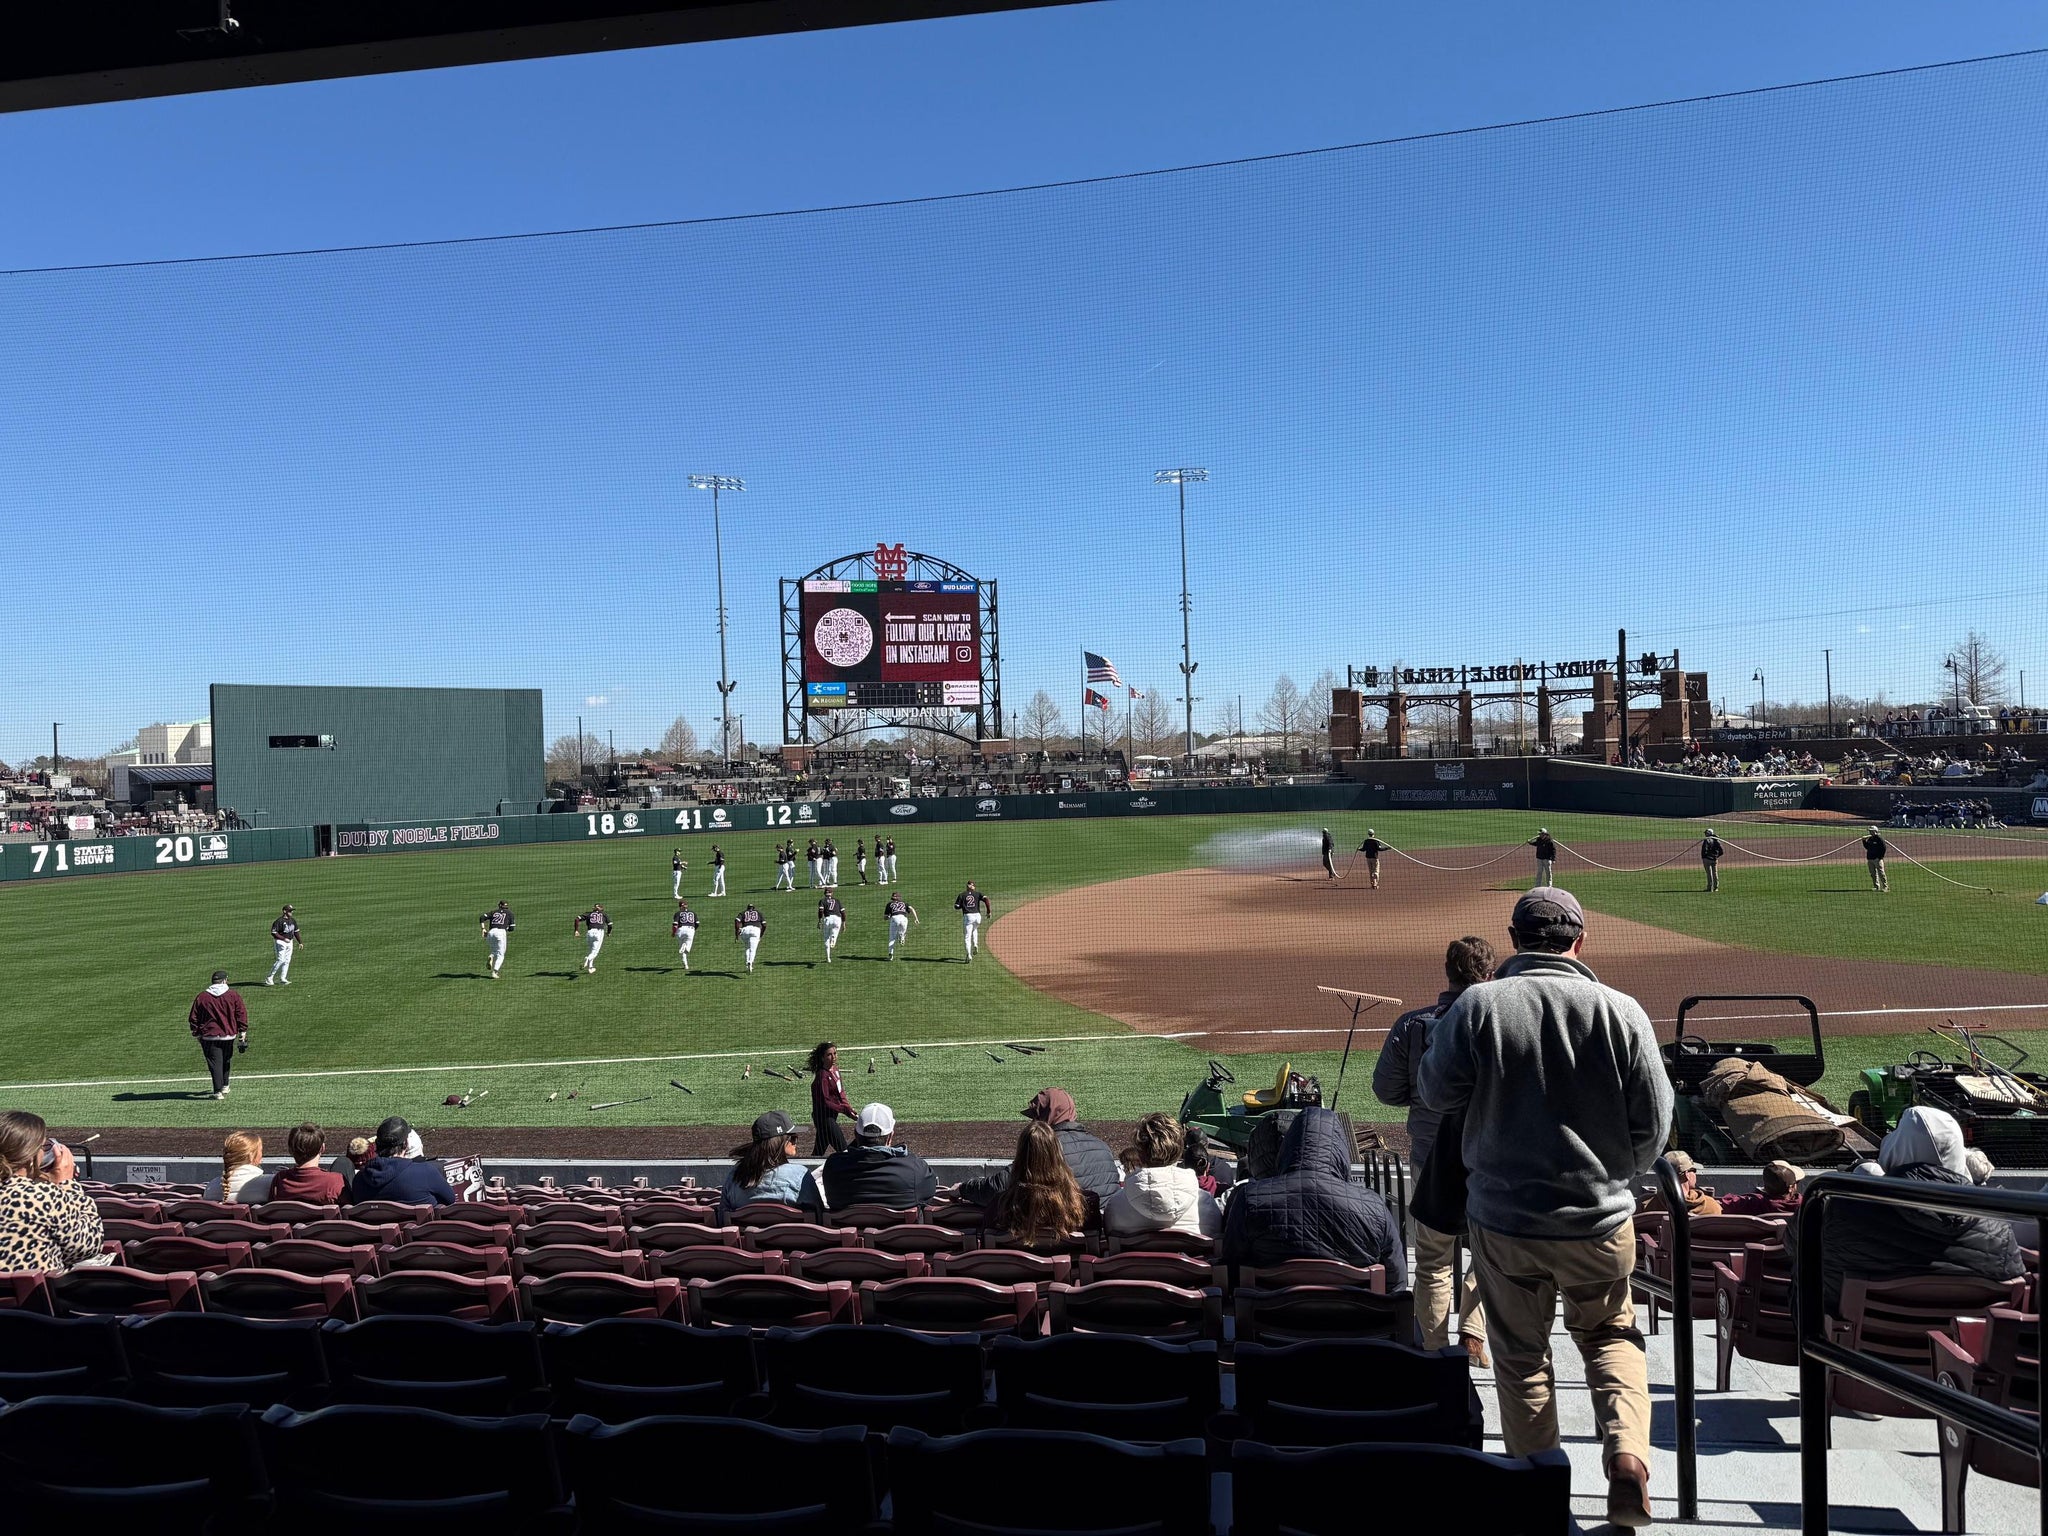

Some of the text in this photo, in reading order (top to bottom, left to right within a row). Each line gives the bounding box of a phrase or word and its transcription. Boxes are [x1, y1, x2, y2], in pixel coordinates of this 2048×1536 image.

[922, 614, 971, 622] SCAN NOW TO
[886, 623, 971, 642] FOLLOW OUR PLAYERS
[886, 644, 950, 663] ON INSTAGRAM!
[833, 706, 958, 719] MIZE FOUNDATION
[1758, 730, 1786, 739] BERM
[1453, 789, 1497, 800] PLAZA
[1780, 790, 1803, 798] RIVER
[675, 809, 702, 830] 41
[766, 805, 792, 826] 12
[587, 813, 615, 836] 18
[339, 823, 499, 847] DUDY NOBLE FIELD
[73, 845, 104, 855] STATE
[156, 836, 193, 864] 20
[31, 844, 69, 873] 71
[74, 855, 105, 866] SHOW
[890, 902, 906, 913] 22
[967, 895, 975, 908] 2
[491, 912, 507, 925] 21
[590, 912, 603, 924] 31
